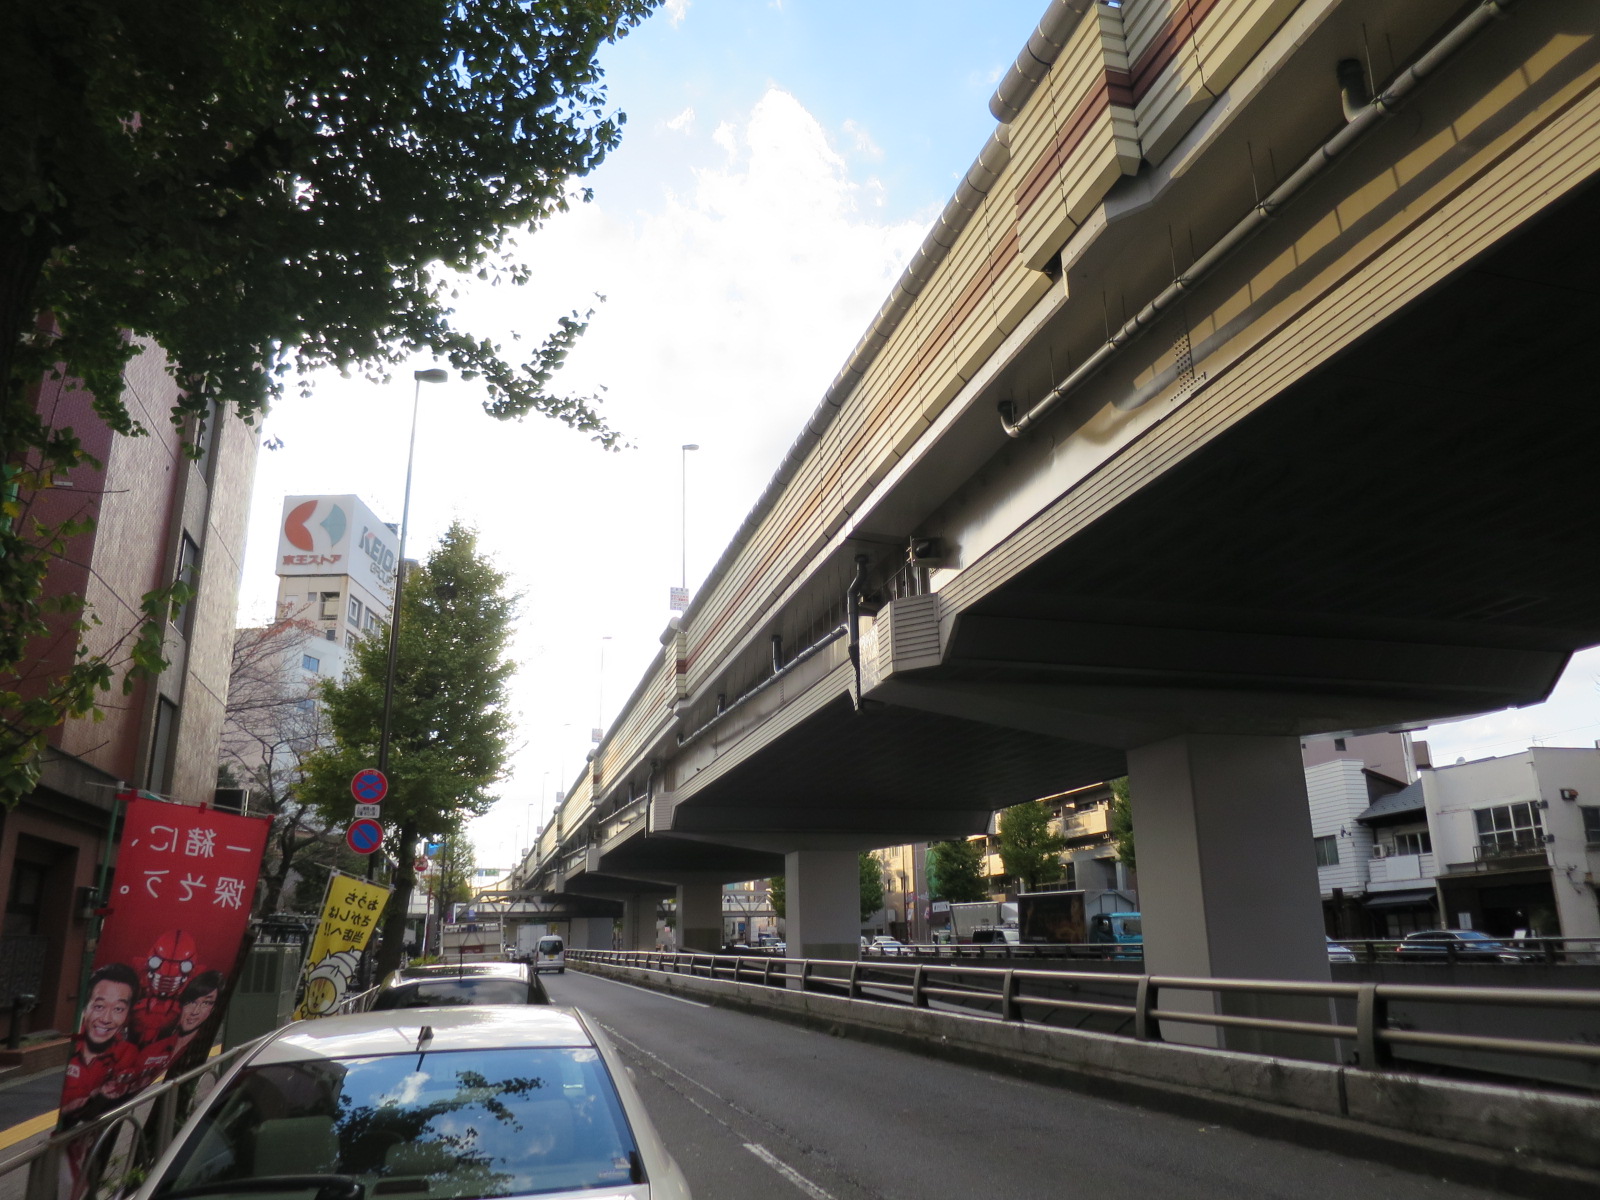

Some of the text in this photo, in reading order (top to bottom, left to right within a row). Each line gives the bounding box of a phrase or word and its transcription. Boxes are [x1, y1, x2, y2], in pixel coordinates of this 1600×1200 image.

[282, 554, 342, 565] 京王ストア
[358, 526, 394, 572] KEIO
